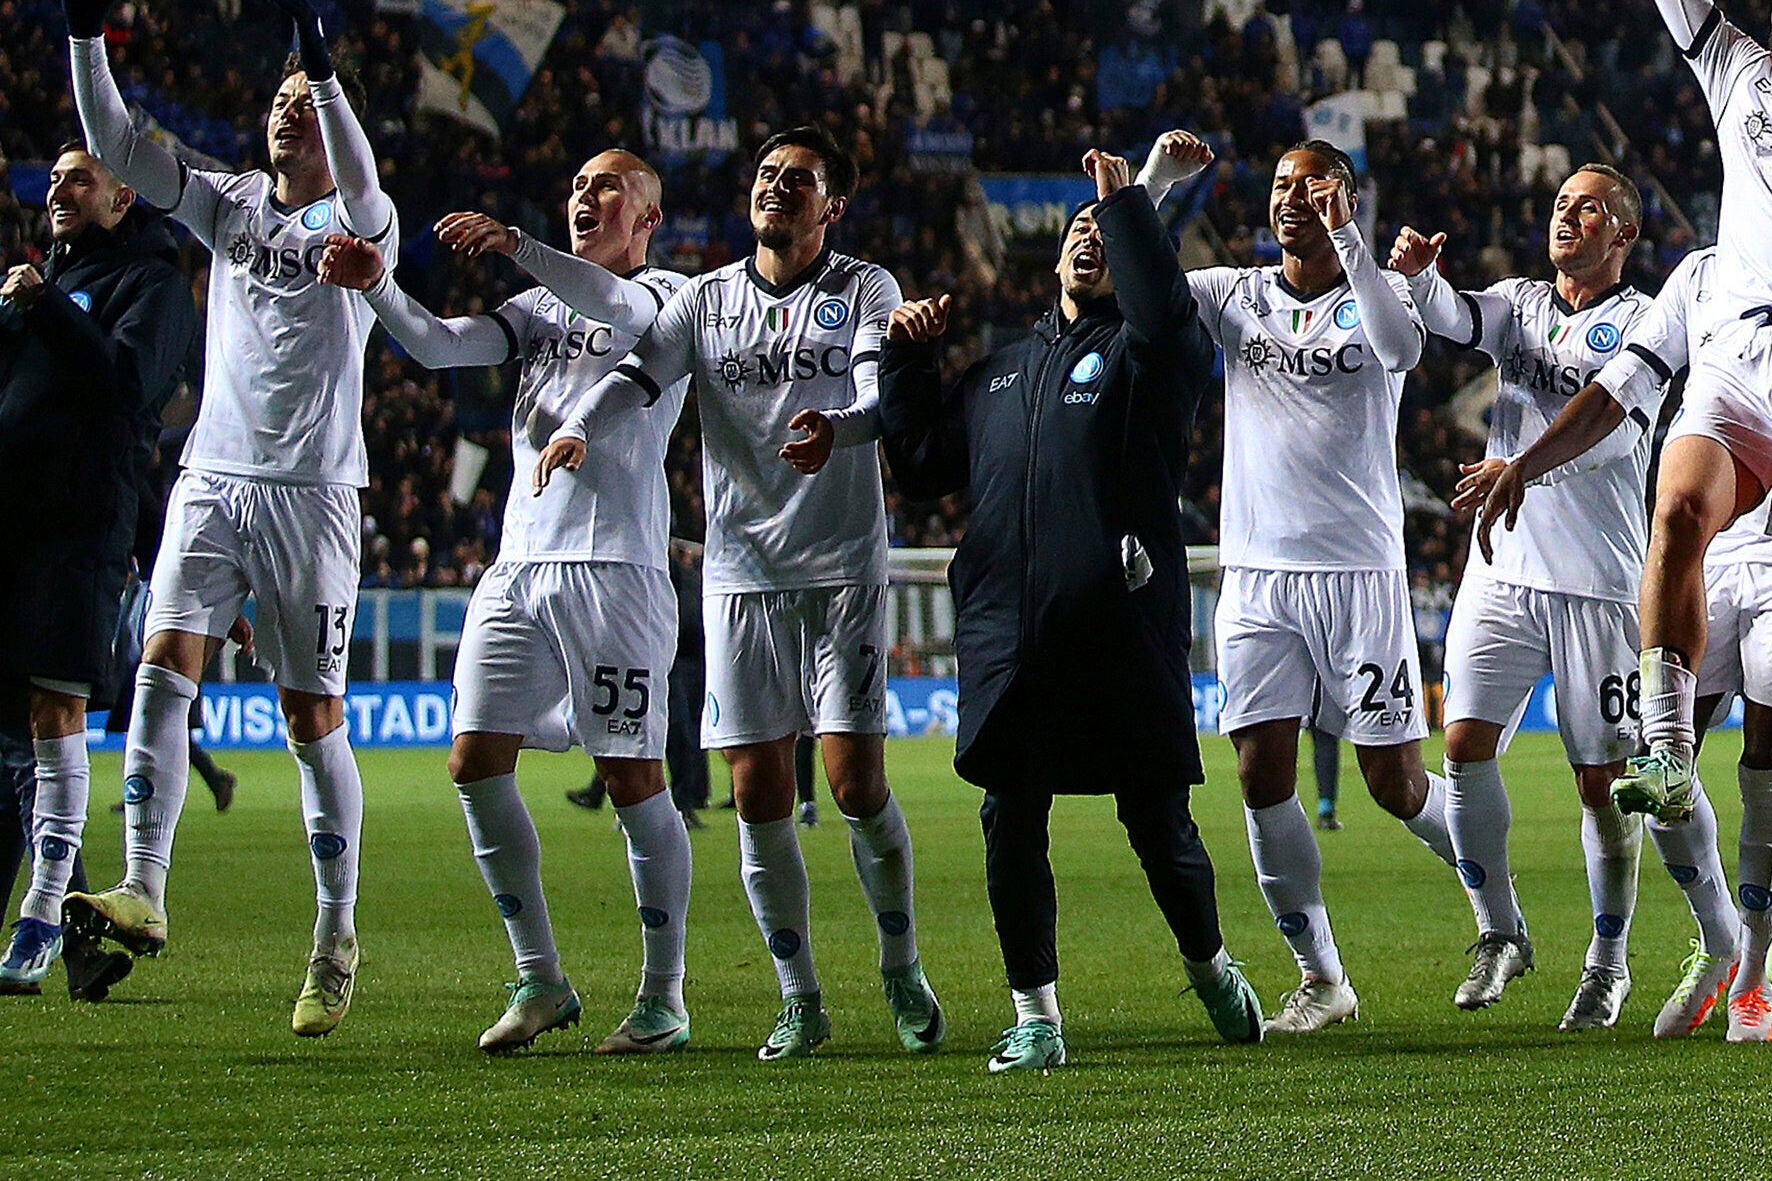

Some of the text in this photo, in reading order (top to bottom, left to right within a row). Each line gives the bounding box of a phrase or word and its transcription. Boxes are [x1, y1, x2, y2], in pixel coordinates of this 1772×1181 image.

[706, 313, 741, 330] EA7
[755, 346, 849, 386] MSC
[1278, 344, 1363, 377] MSC
[988, 371, 1019, 393] EA7
[1063, 390, 1100, 405] ebay
[314, 604, 347, 656] 13
[591, 665, 650, 719] 55
[1357, 658, 1414, 712] 24
[1599, 669, 1641, 725] 68
[607, 719, 642, 735] EA7
[1380, 710, 1412, 726] EA7
